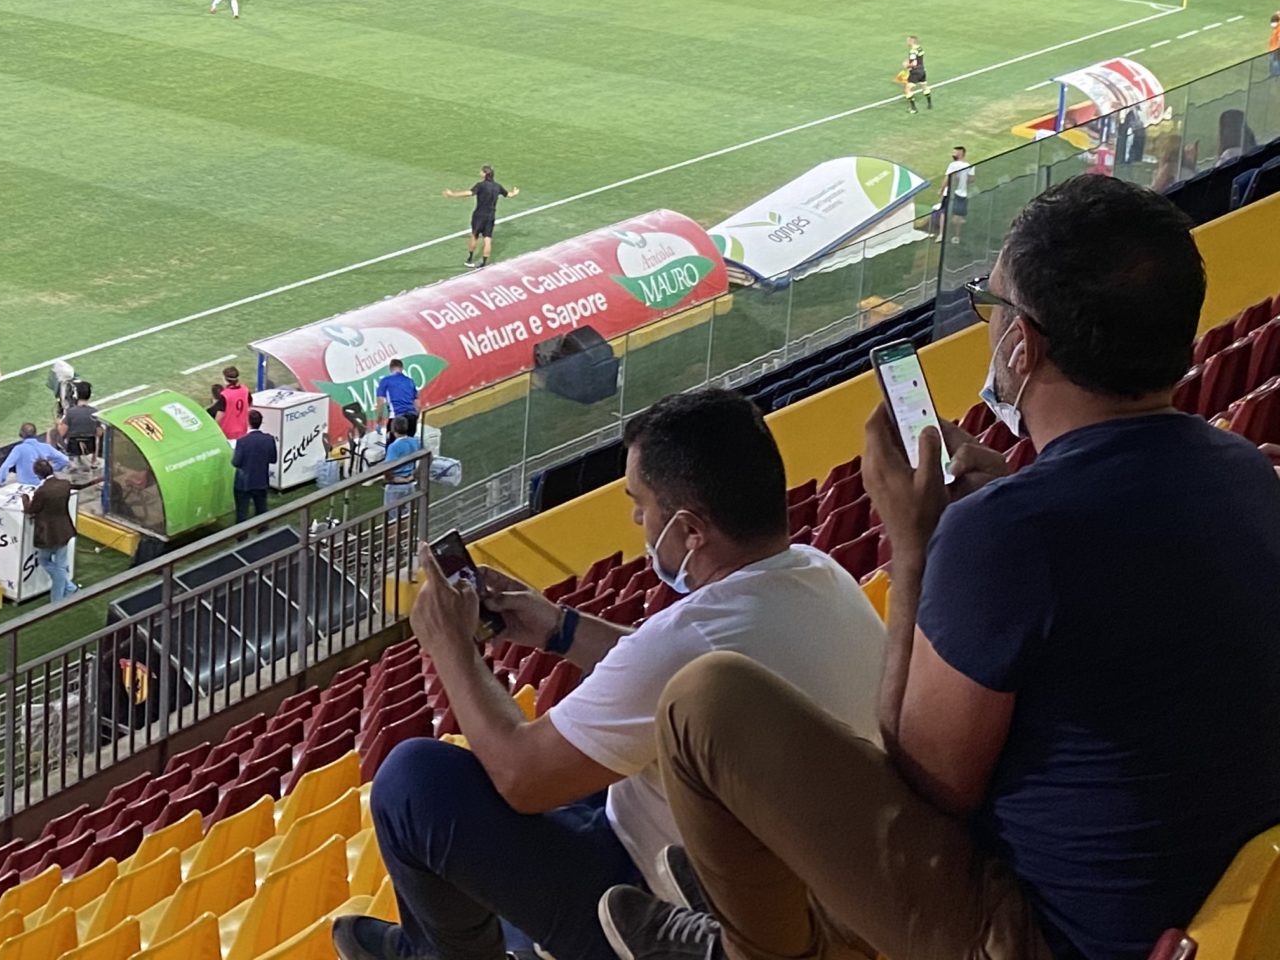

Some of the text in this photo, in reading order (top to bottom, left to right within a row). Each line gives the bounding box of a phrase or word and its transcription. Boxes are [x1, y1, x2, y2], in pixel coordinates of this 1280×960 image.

[641, 244, 676, 271] Avicola
[419, 259, 603, 330] Dalla Valle Caudina
[637, 263, 700, 307] MAURO
[459, 291, 609, 360] Natura e Sapore
[354, 341, 398, 374] Avicola
[235, 398, 244, 418] 9
